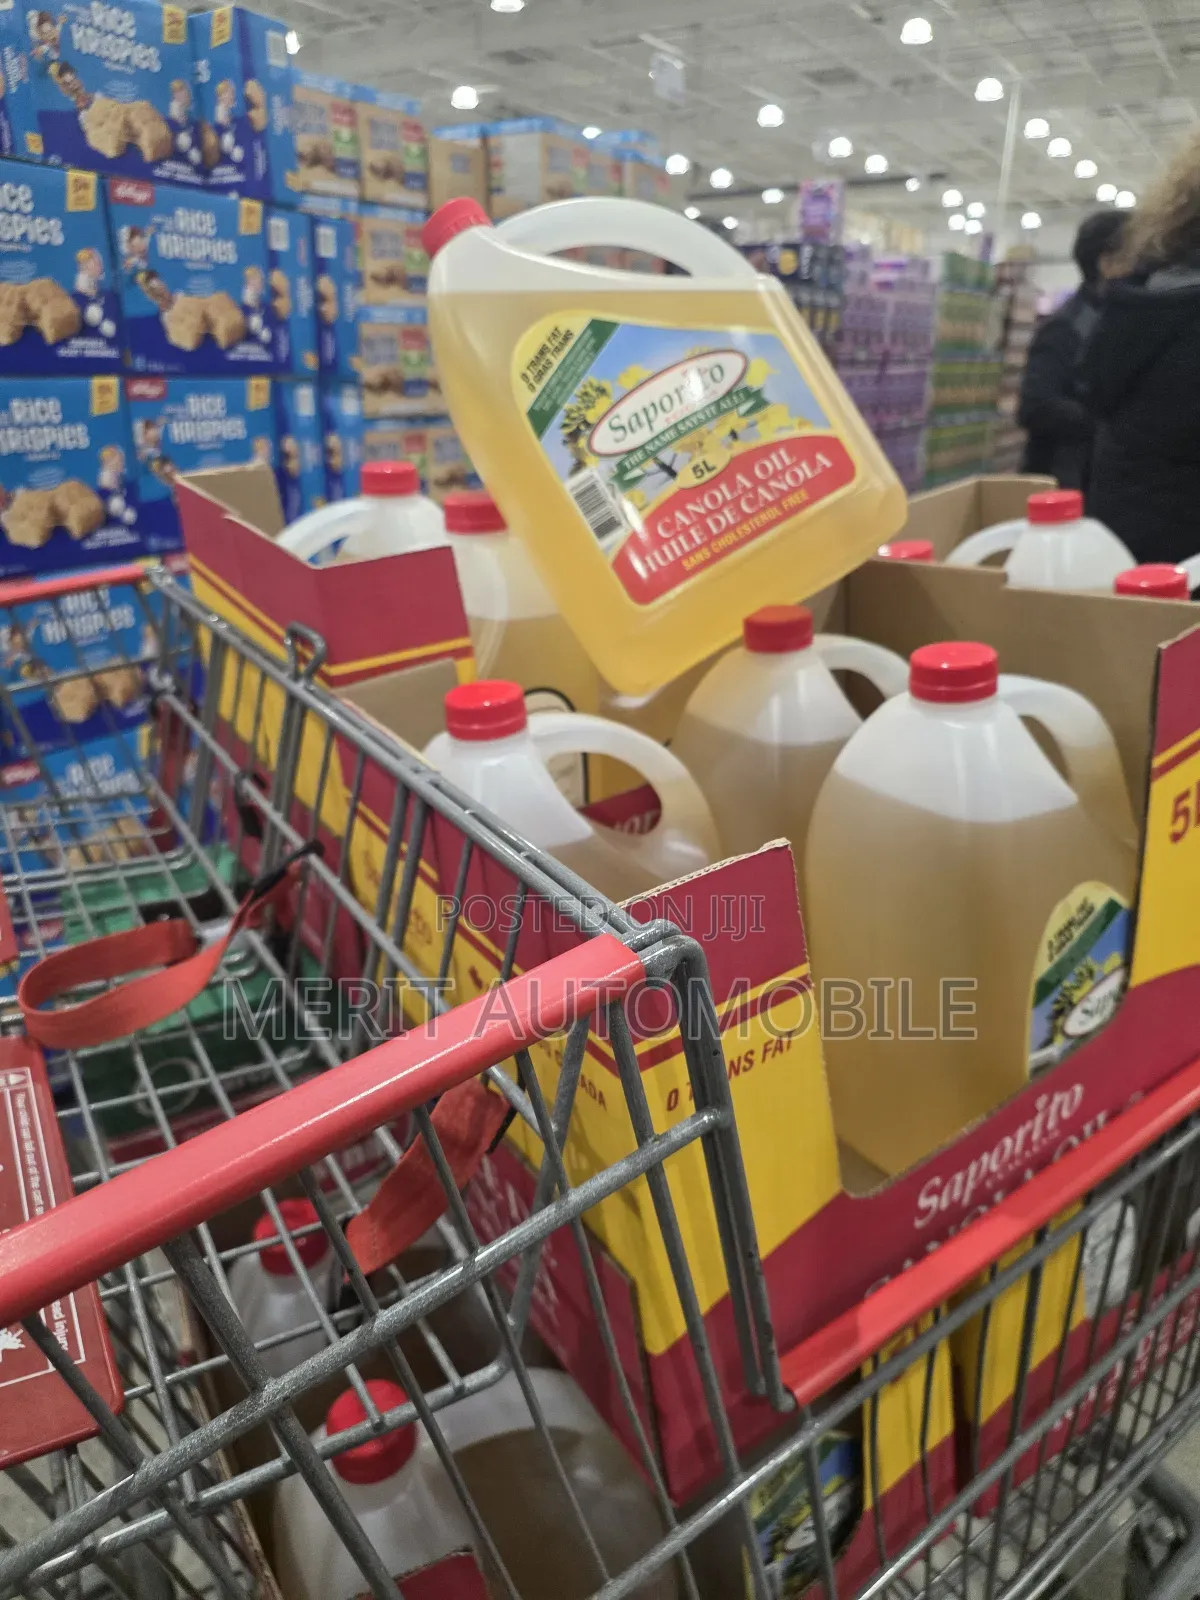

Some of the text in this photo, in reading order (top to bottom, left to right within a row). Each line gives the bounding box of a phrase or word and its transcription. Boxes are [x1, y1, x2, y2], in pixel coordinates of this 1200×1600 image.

[648, 427, 679, 454] NAME
[691, 459, 717, 480] 5L
[657, 446, 798, 539] CANOLA OIL
[706, 503, 740, 535] DE
[740, 451, 833, 514] CANOLA
[761, 1031, 795, 1064] FAT
[913, 1083, 1084, 1229] Saporito
